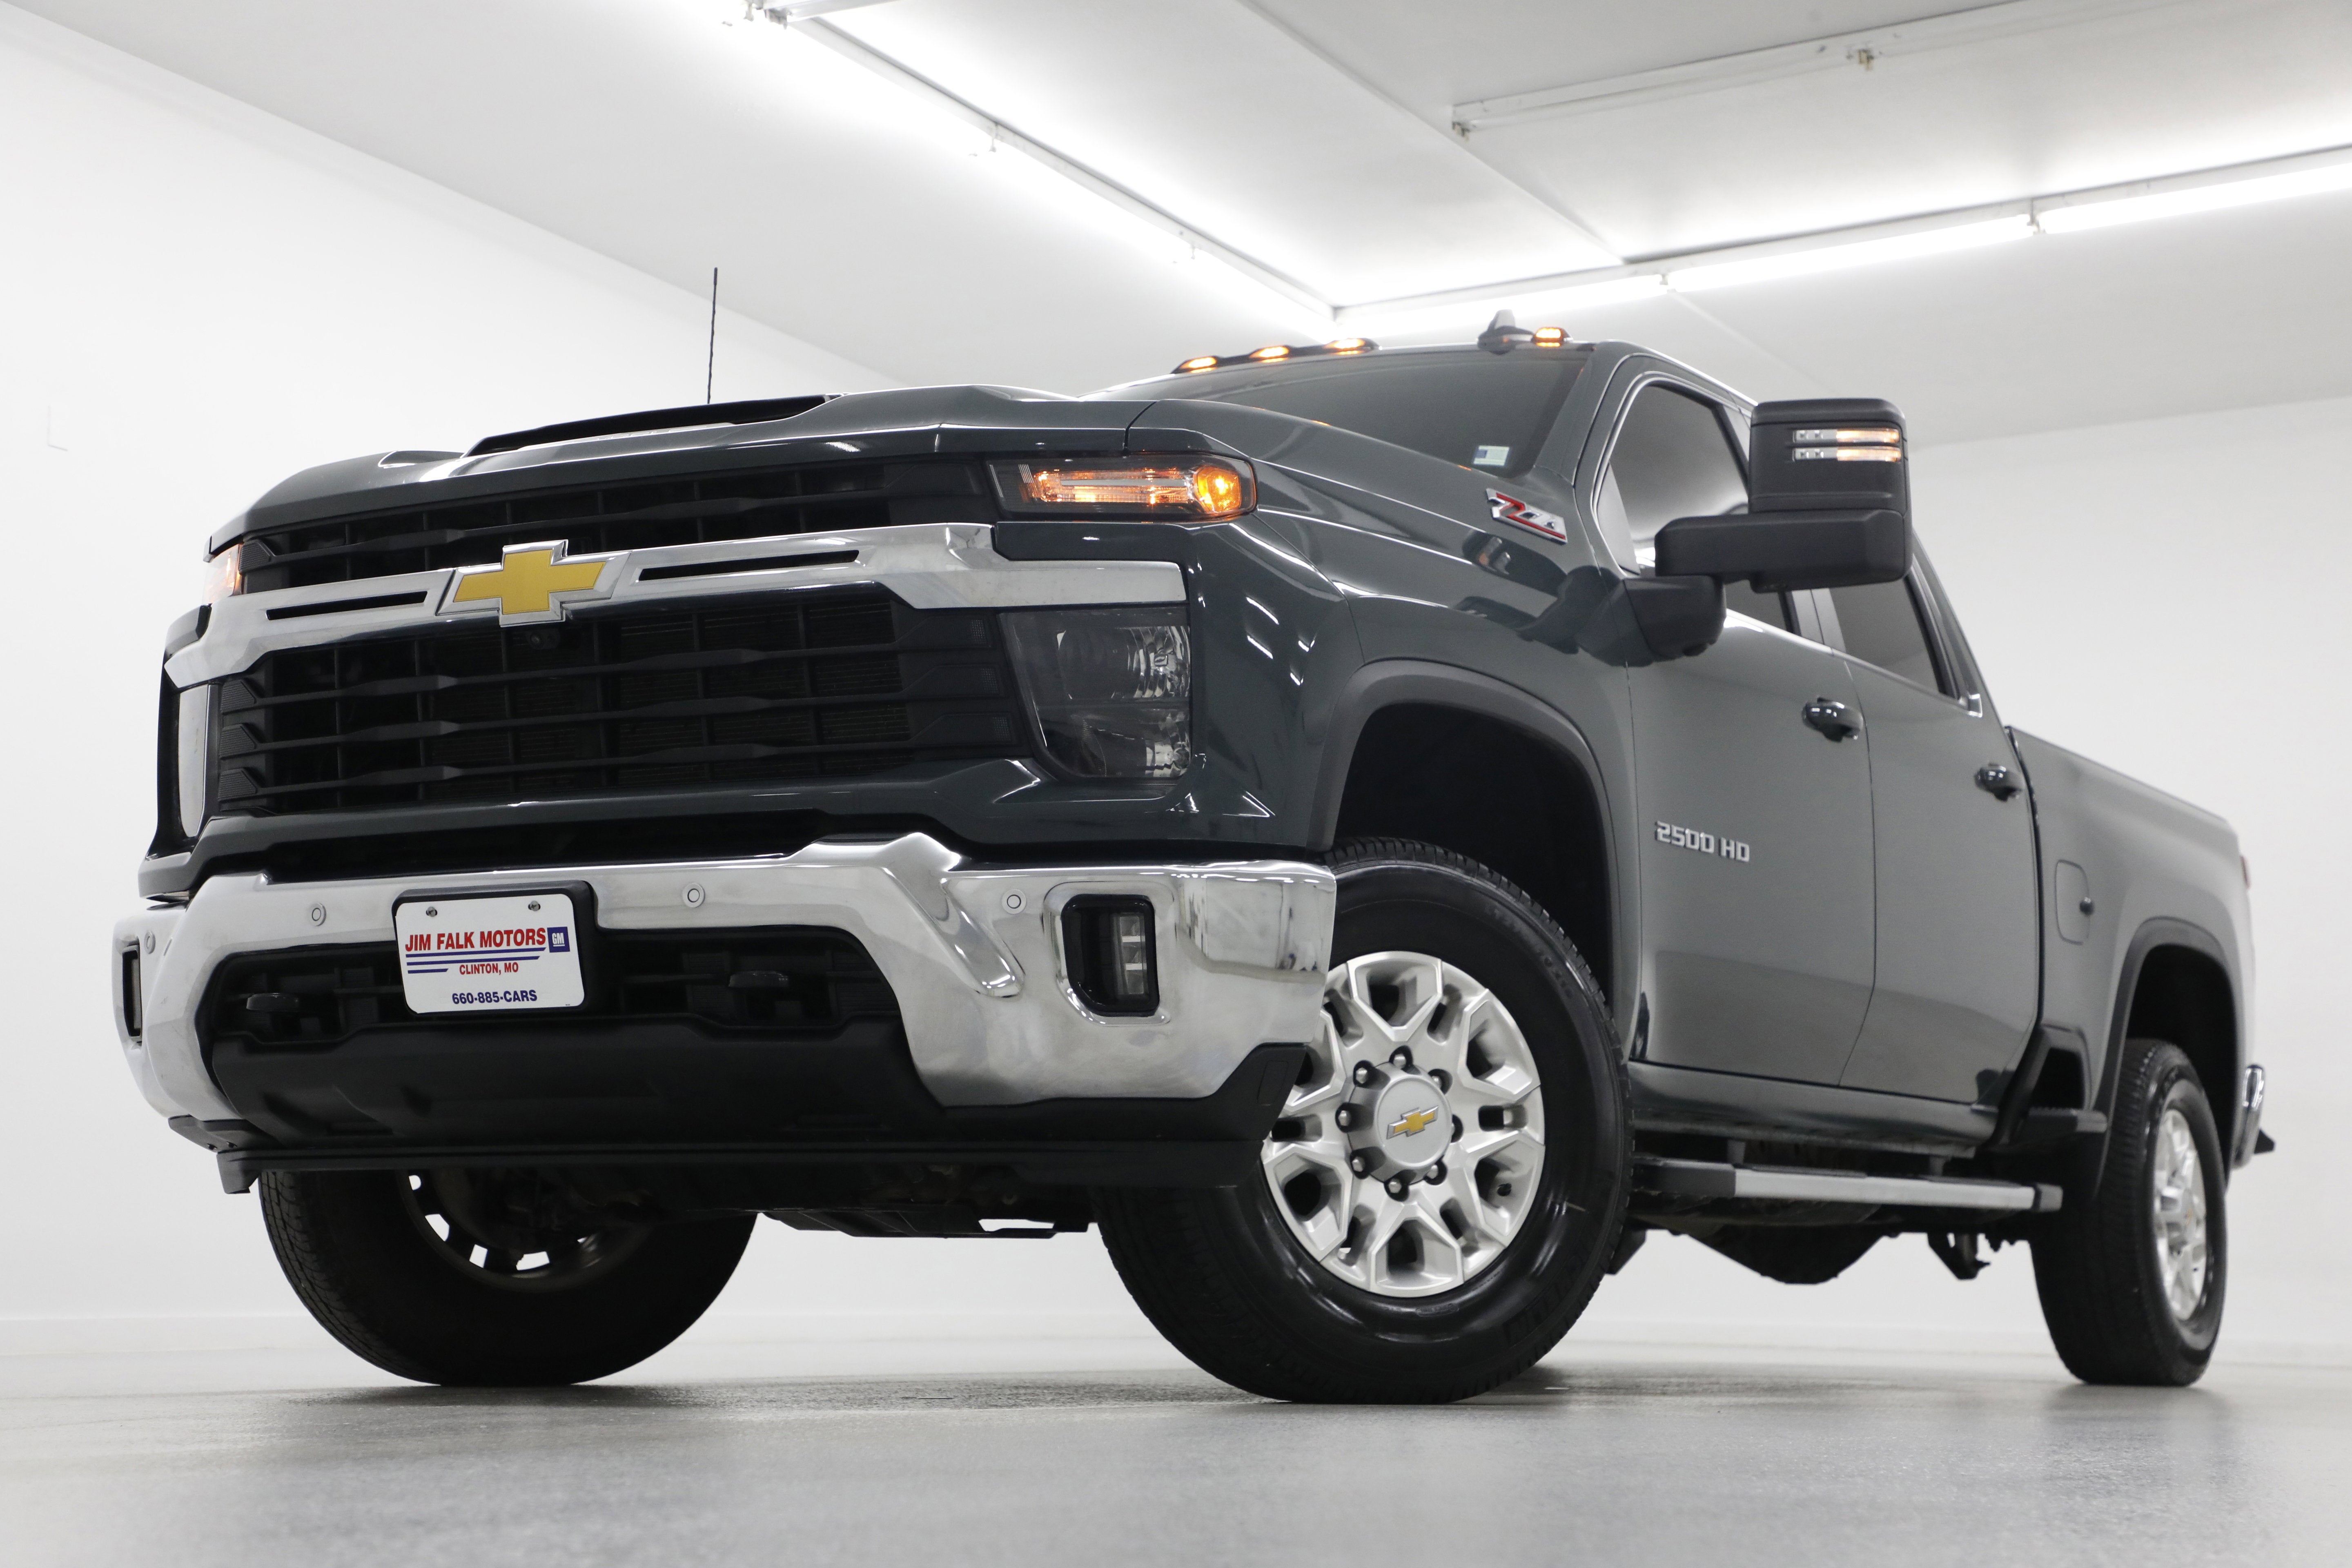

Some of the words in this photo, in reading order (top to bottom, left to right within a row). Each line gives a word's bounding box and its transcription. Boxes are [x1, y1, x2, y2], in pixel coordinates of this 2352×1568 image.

[1486, 488, 1568, 543] Z71
[1656, 820, 1714, 853] 2500
[1719, 837, 1750, 862] HD
[405, 934, 431, 952] JIM
[437, 932, 474, 950] FALK
[480, 927, 546, 948] MOTORS
[552, 933, 565, 944] GM
[459, 963, 501, 975] CLINTON,
[504, 962, 519, 973] MO
[452, 990, 537, 1004] 660-885-CARS
